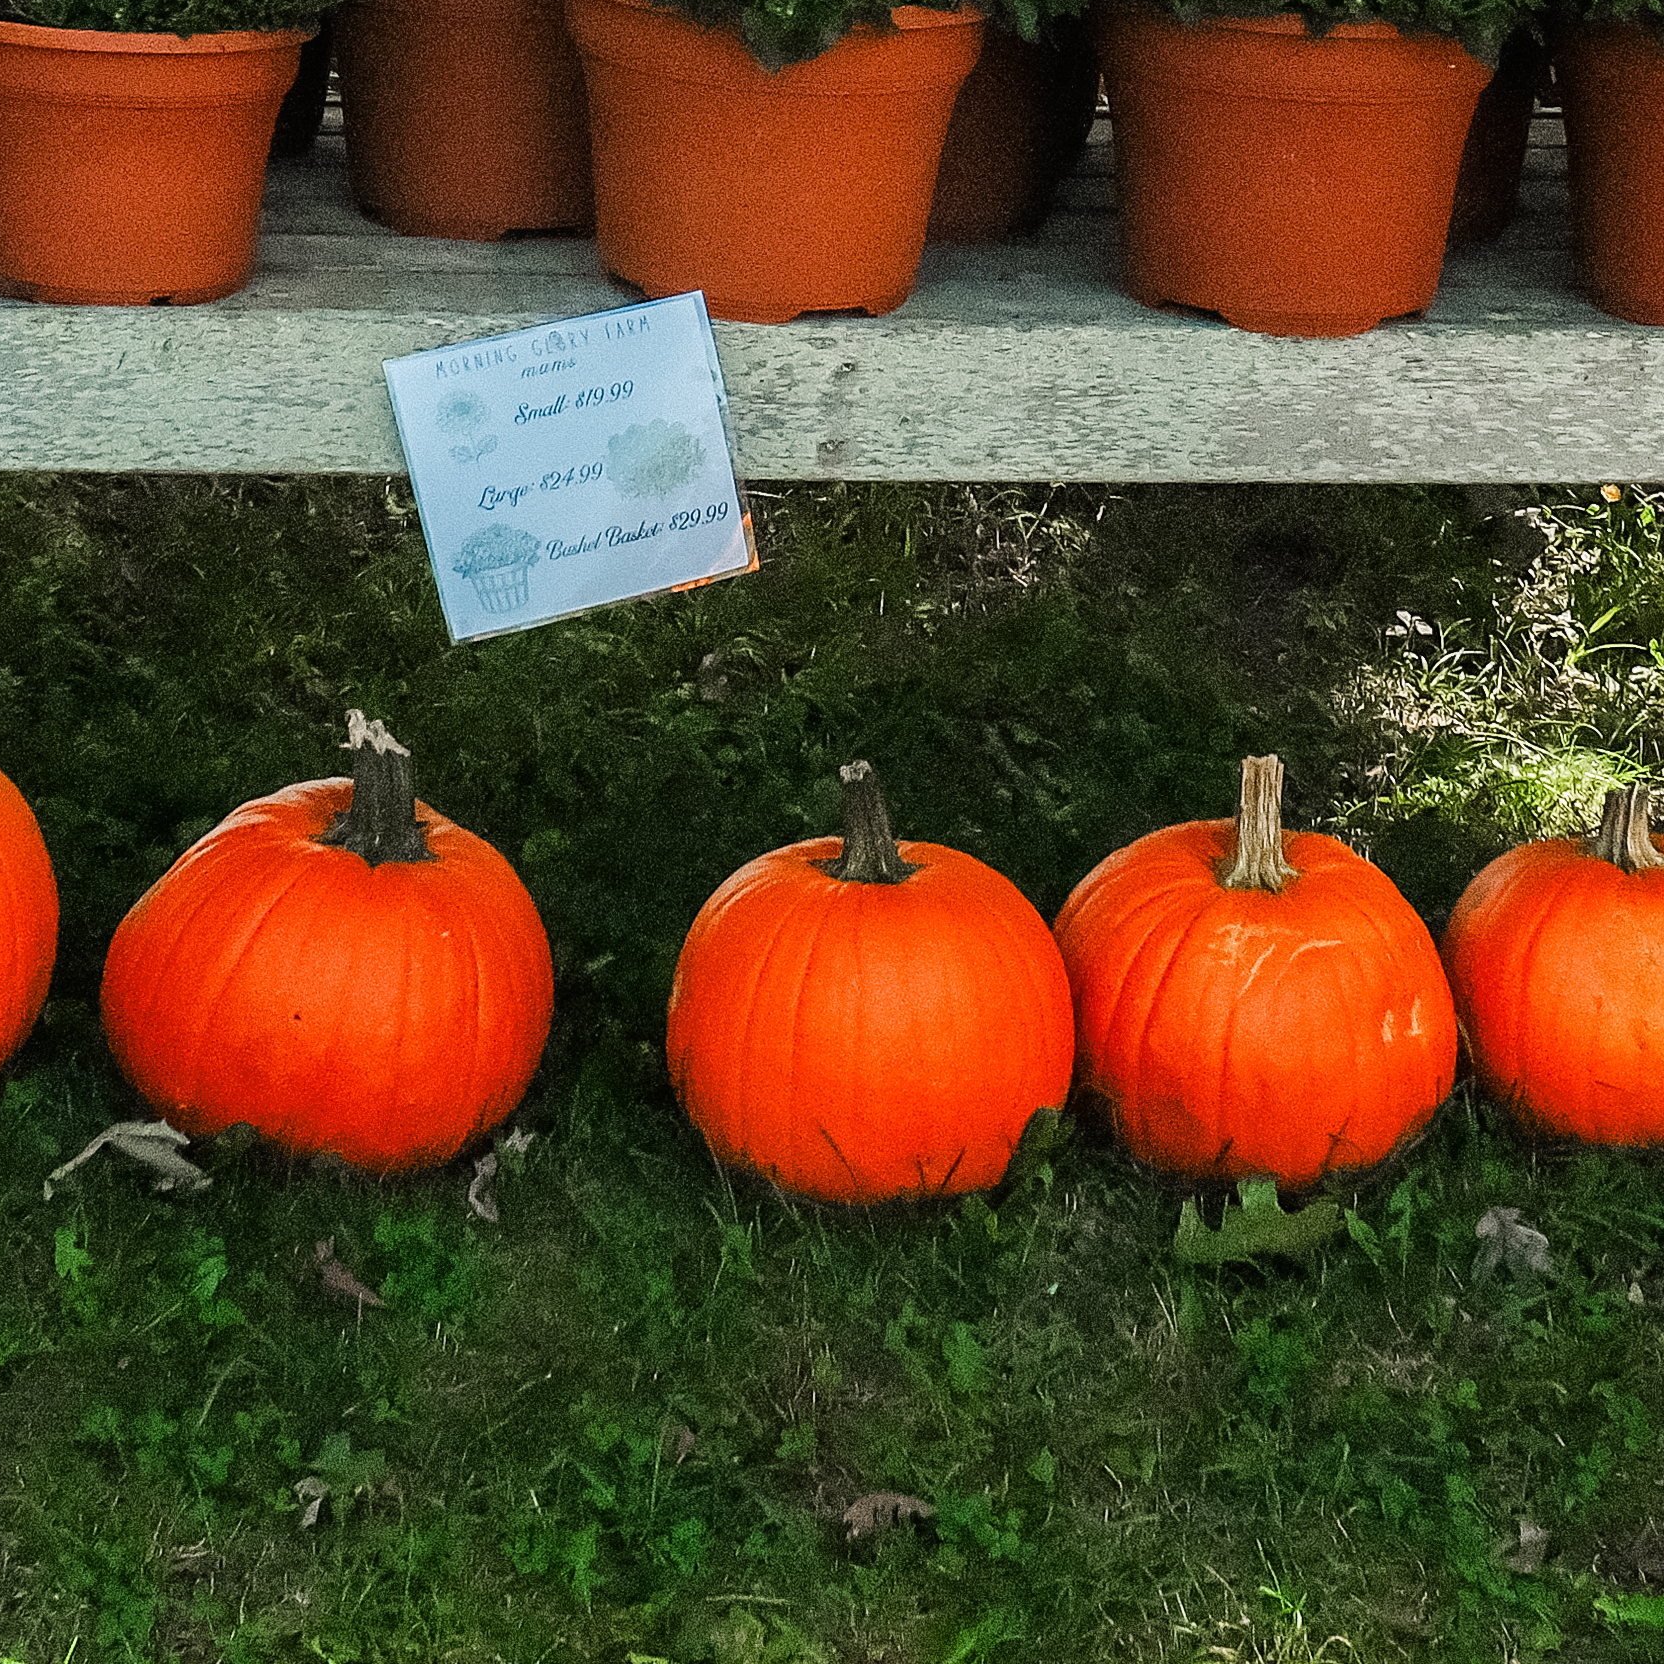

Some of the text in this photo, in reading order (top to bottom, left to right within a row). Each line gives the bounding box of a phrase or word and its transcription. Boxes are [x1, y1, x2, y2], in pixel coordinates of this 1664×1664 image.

[435, 315, 651, 379] MORNING GLORY FARM
[520, 356, 577, 379] mums
[514, 379, 634, 426] Small: $19.99
[477, 461, 604, 511] Large: $24.99
[545, 531, 602, 560] Bushel
[668, 501, 729, 531] $29.99
